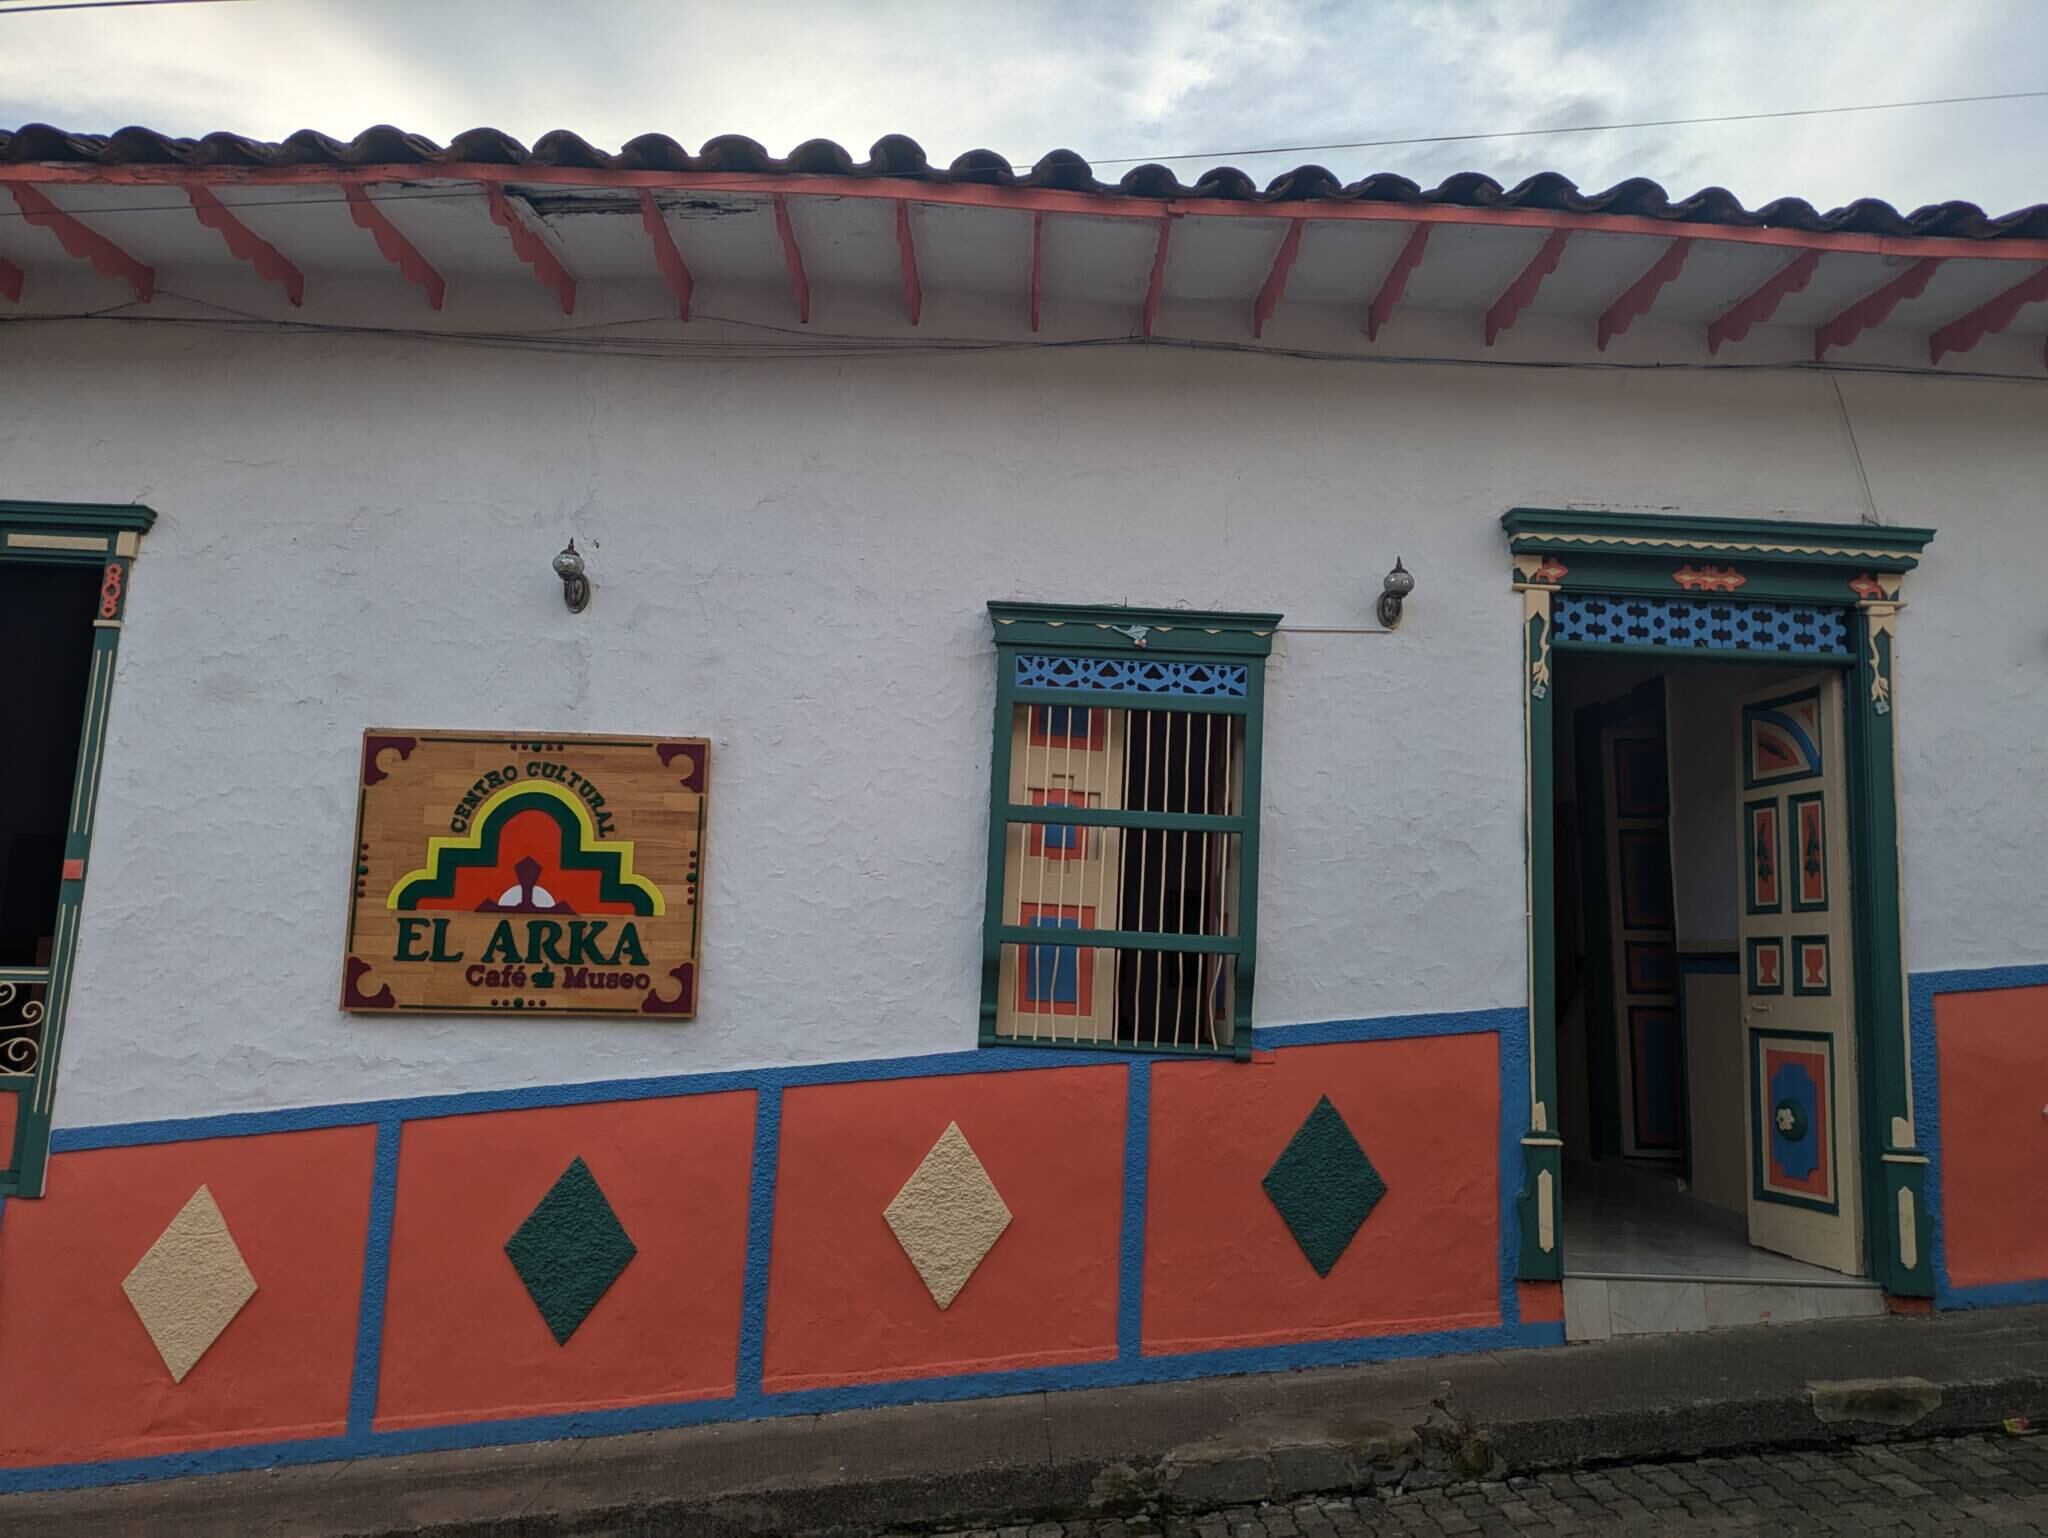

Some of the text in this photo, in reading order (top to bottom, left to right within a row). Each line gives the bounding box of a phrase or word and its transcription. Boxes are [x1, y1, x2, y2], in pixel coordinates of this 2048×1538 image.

[451, 761, 615, 838] CENTRO CULTURAL
[393, 917, 650, 966] EL ARKA
[465, 964, 650, 989] Café Museo
